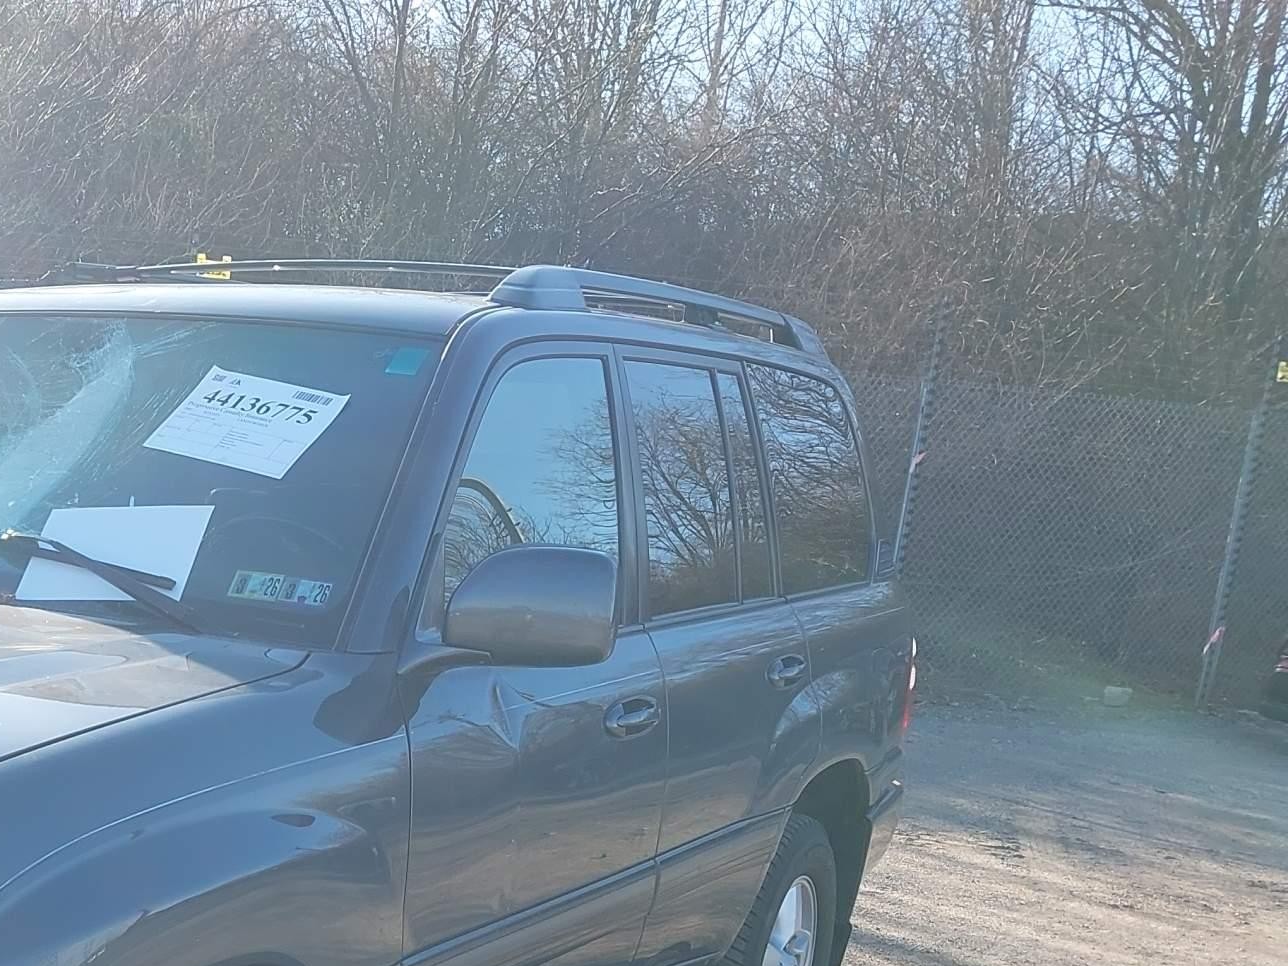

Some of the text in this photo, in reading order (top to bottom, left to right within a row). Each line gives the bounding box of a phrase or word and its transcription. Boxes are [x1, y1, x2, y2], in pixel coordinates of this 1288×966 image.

[203, 389, 319, 425] 44136775
[263, 577, 281, 597] 26
[312, 584, 331, 603] 26
